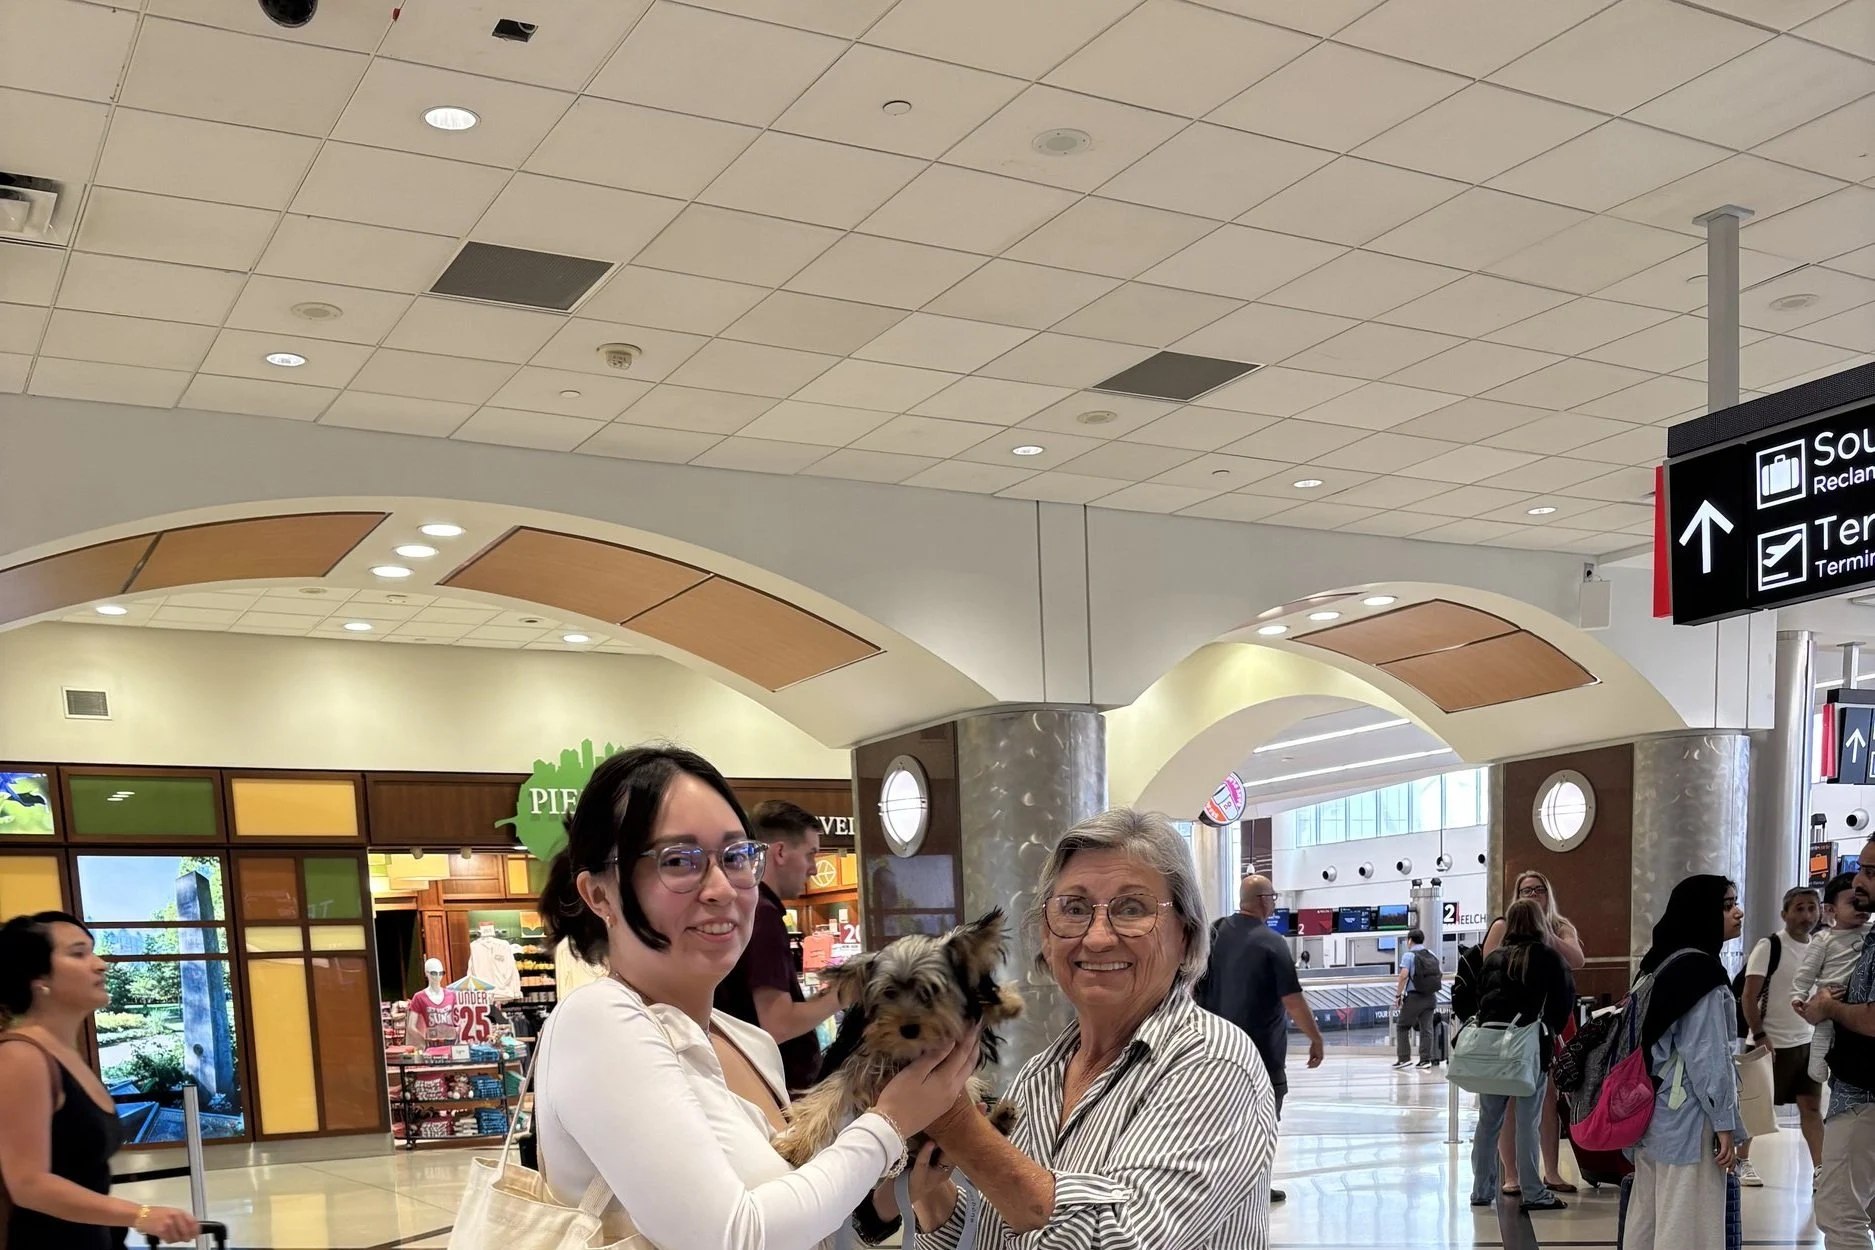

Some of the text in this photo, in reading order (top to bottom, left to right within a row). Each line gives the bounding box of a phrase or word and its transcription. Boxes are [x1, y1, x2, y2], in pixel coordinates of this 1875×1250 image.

[1814, 428, 1875, 466] Sou
[1814, 514, 1875, 550] Ter
[529, 787, 583, 814] PIE
[1443, 904, 1455, 923] 2
[1459, 914, 1487, 925] EELCH
[1298, 923, 1305, 935] 2
[457, 991, 488, 1005] UNDER
[453, 1006, 490, 1042] $25
